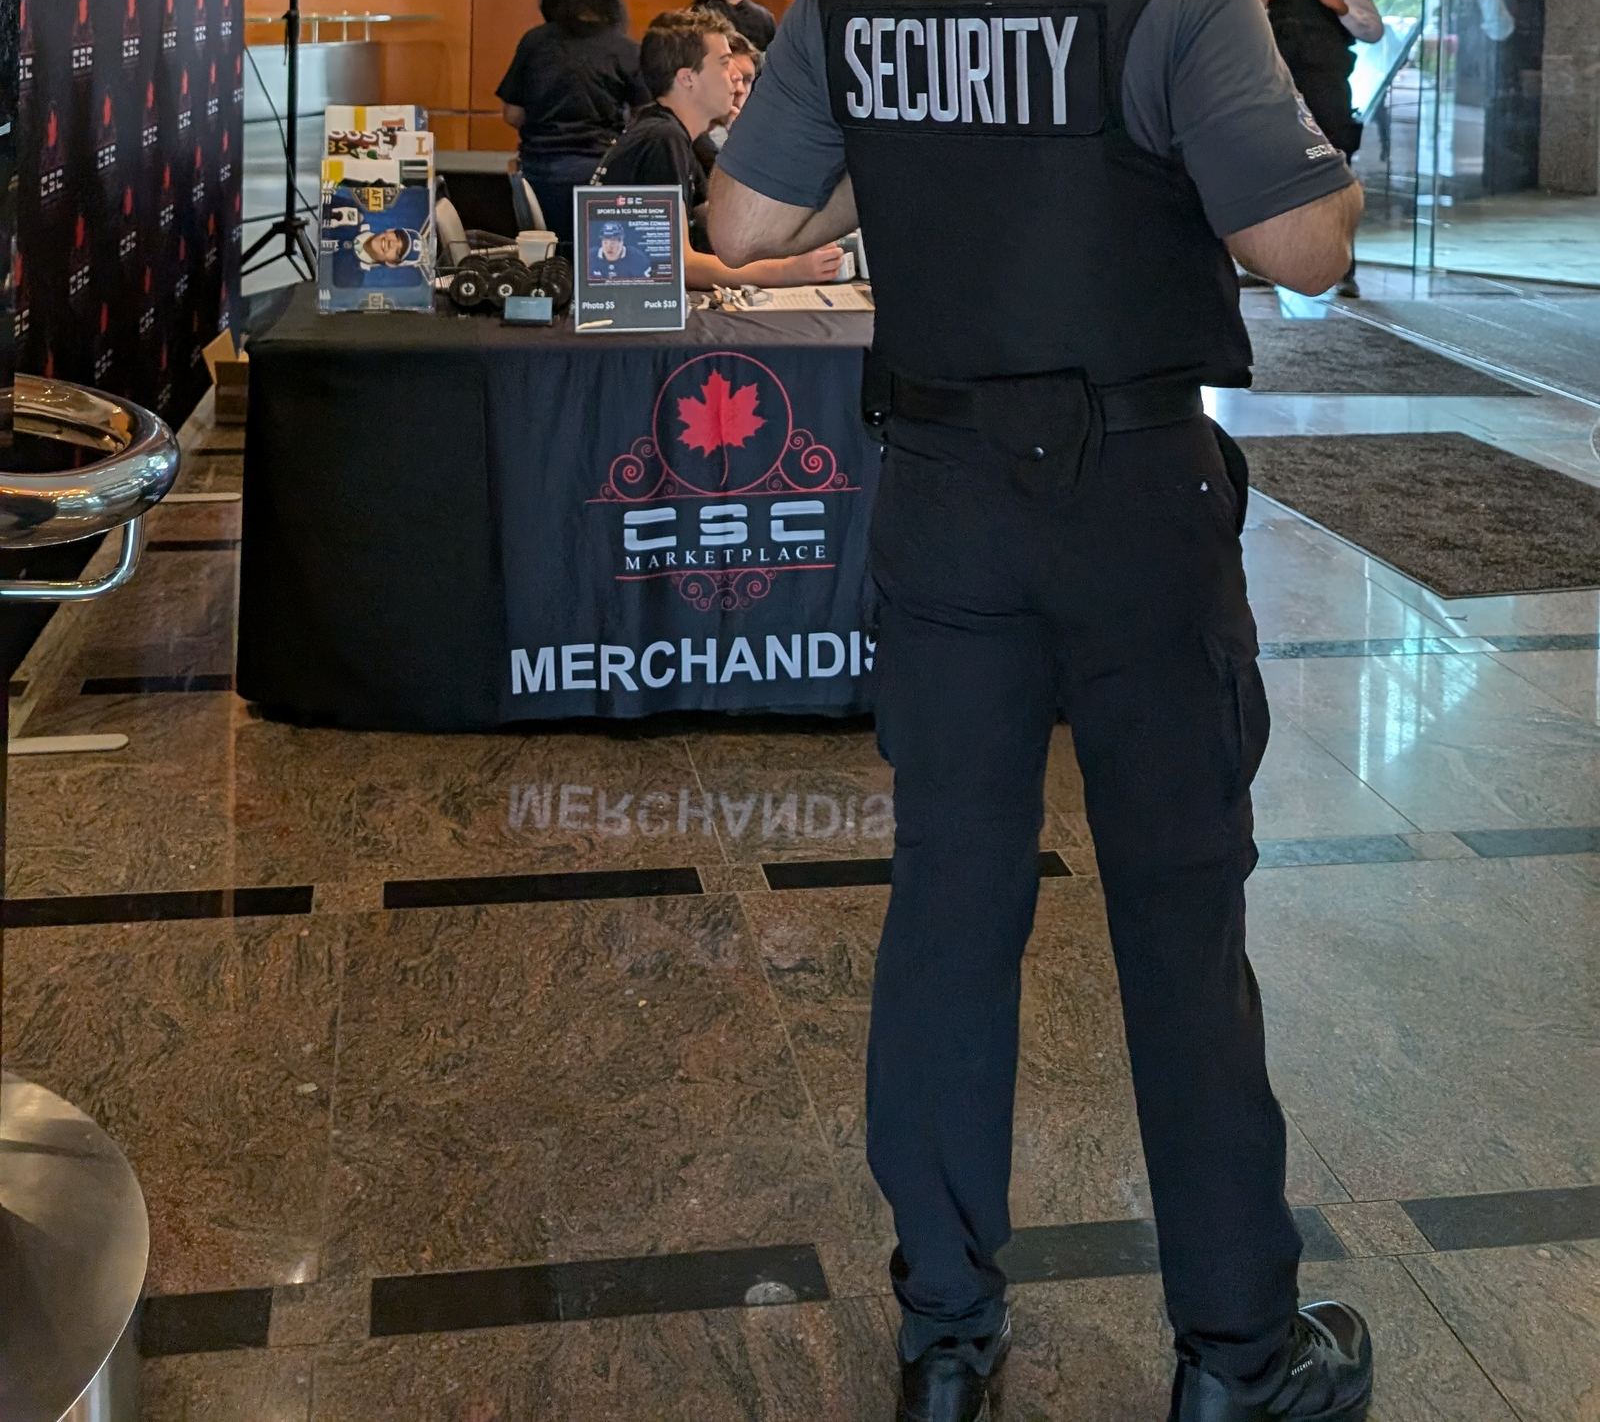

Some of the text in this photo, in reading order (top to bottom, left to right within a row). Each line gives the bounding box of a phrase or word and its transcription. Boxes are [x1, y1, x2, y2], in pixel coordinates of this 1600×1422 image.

[73, 47, 92, 68] CSC
[123, 39, 139, 57] CSC
[845, 16, 1078, 125] SECURITY
[98, 145, 115, 168] CSC
[41, 169, 62, 196] CSC
[120, 231, 136, 256] CSC
[70, 266, 89, 294] CSC
[582, 300, 616, 310] Photo $5
[643, 299, 678, 309] Puck $10
[624, 499, 826, 552] CSC
[625, 544, 827, 572] MARKETPLACE
